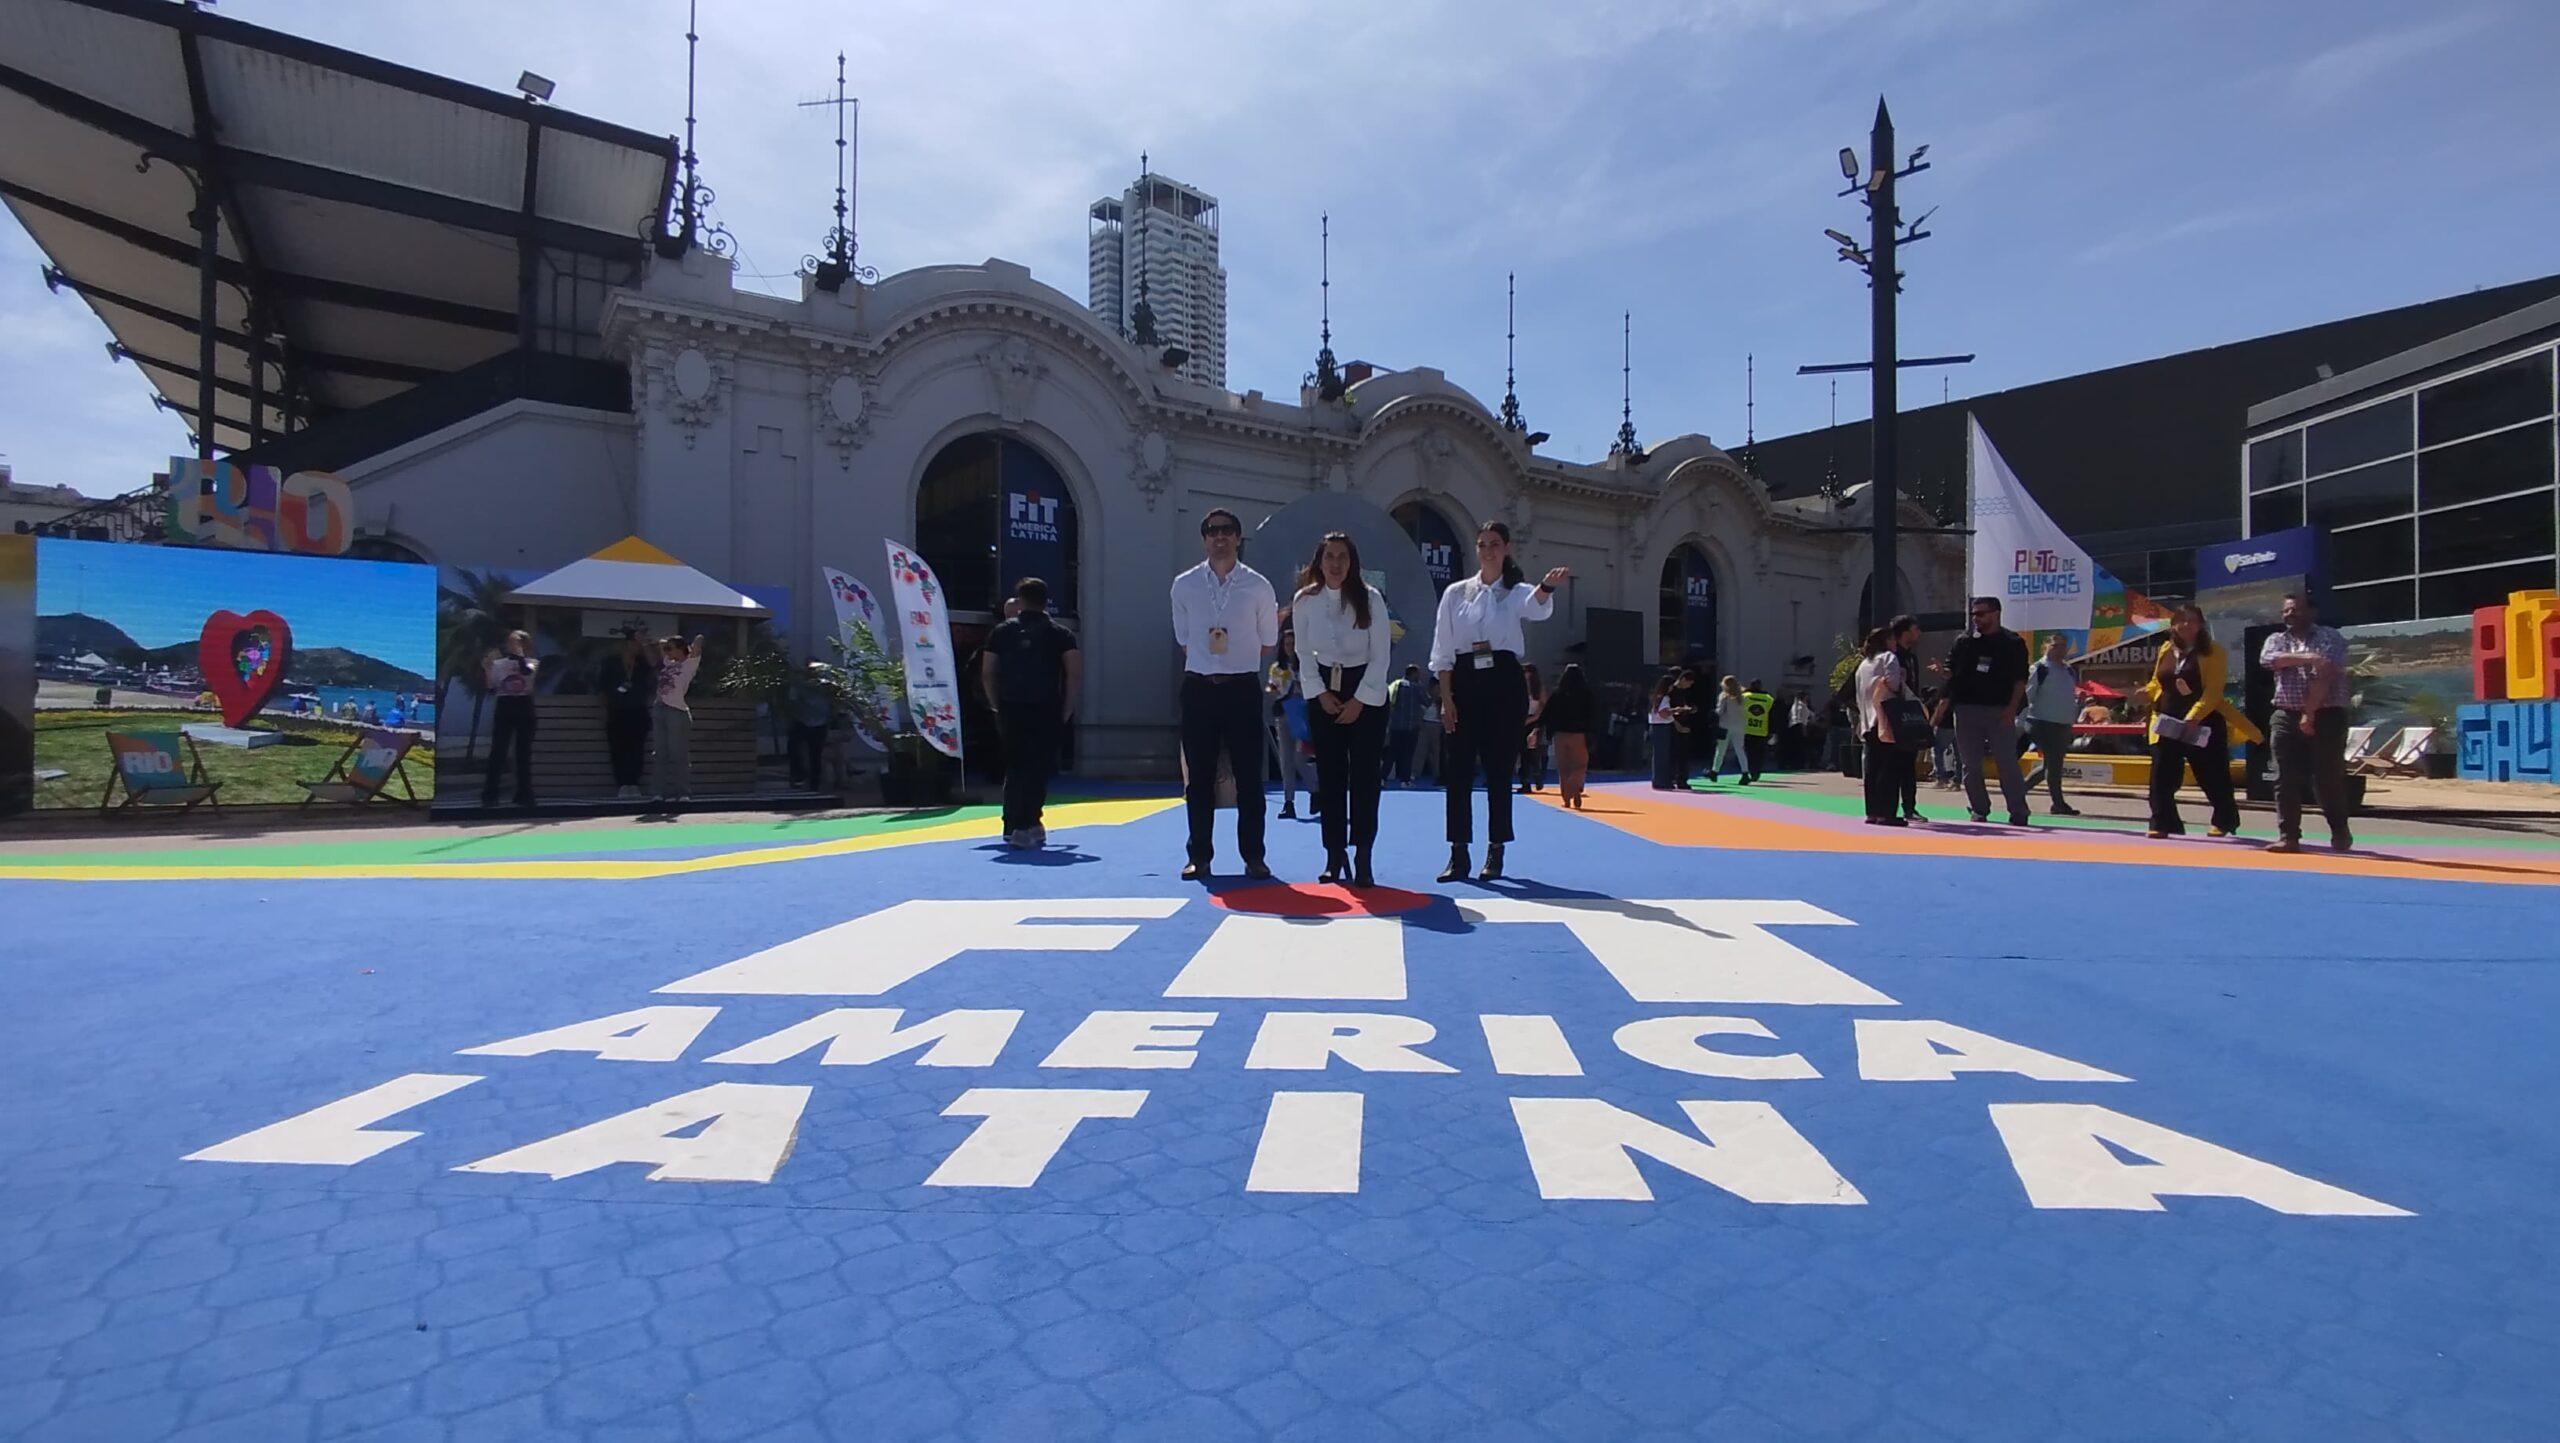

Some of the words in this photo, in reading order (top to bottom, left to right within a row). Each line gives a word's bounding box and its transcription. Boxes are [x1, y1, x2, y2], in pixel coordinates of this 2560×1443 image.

[169, 456, 353, 555] RIO
[1010, 521, 1057, 533] AMERICA
[1010, 530, 1057, 542] LATINA
[123, 751, 172, 774] RIO
[454, 1006, 2135, 1083] AMERICA
[180, 1073, 2418, 1217] LATINA
